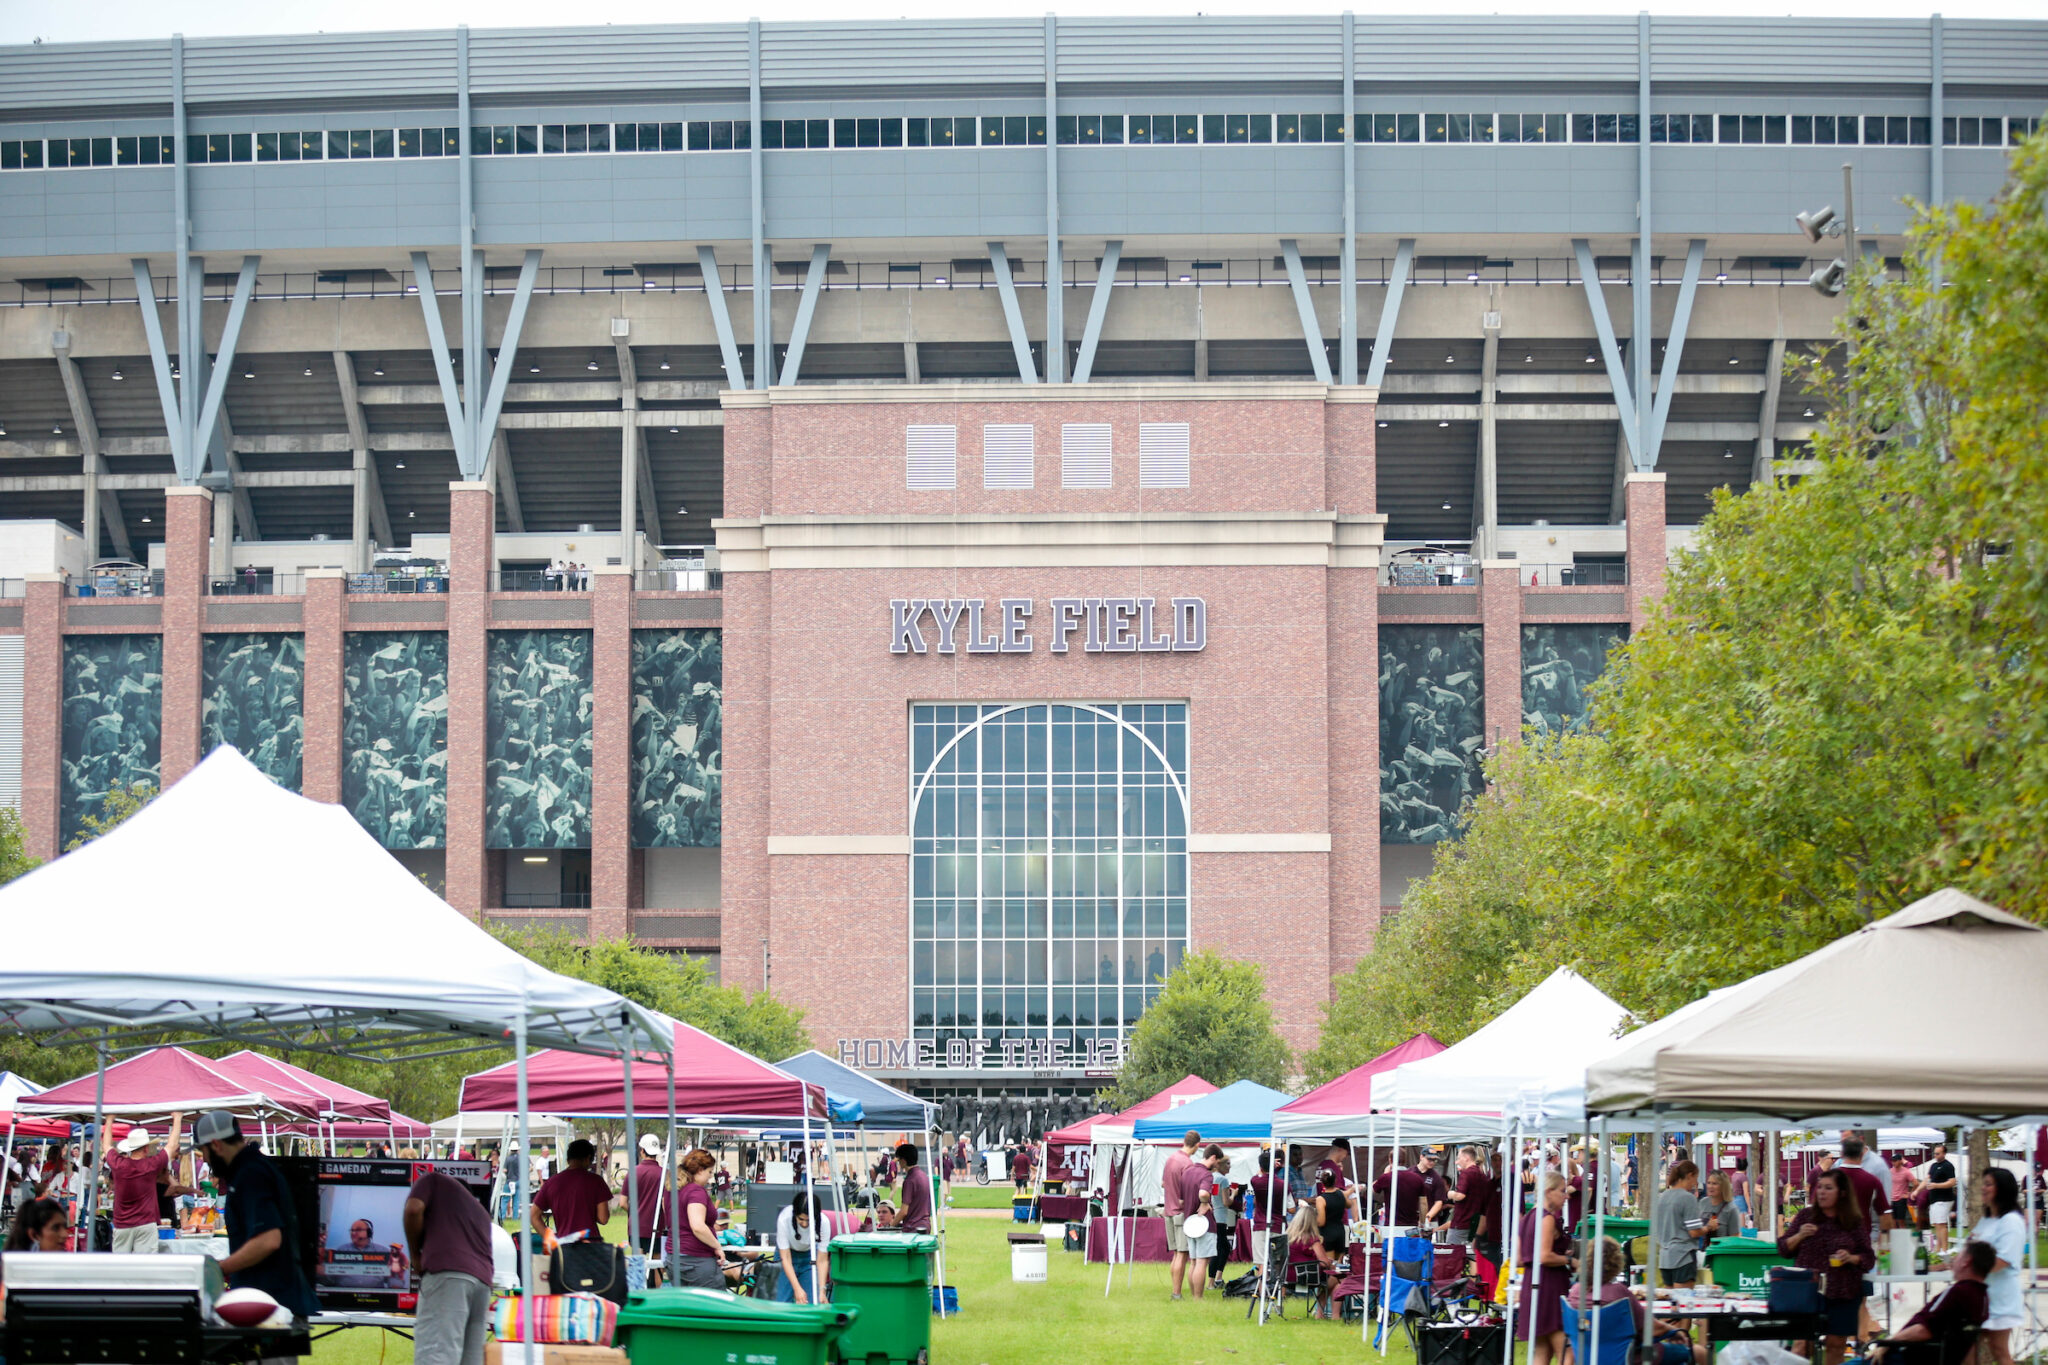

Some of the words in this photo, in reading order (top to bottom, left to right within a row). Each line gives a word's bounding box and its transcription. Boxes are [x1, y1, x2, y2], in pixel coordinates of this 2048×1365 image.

[890, 599, 1033, 654] KYLE
[1050, 597, 1207, 653] FIELD
[838, 1038, 935, 1068] HOME
[946, 1038, 992, 1068] OF
[1000, 1038, 1071, 1068] THE
[326, 1164, 372, 1174] GAMEDAY
[434, 1167, 447, 1175] NC
[449, 1167, 480, 1176] STATE
